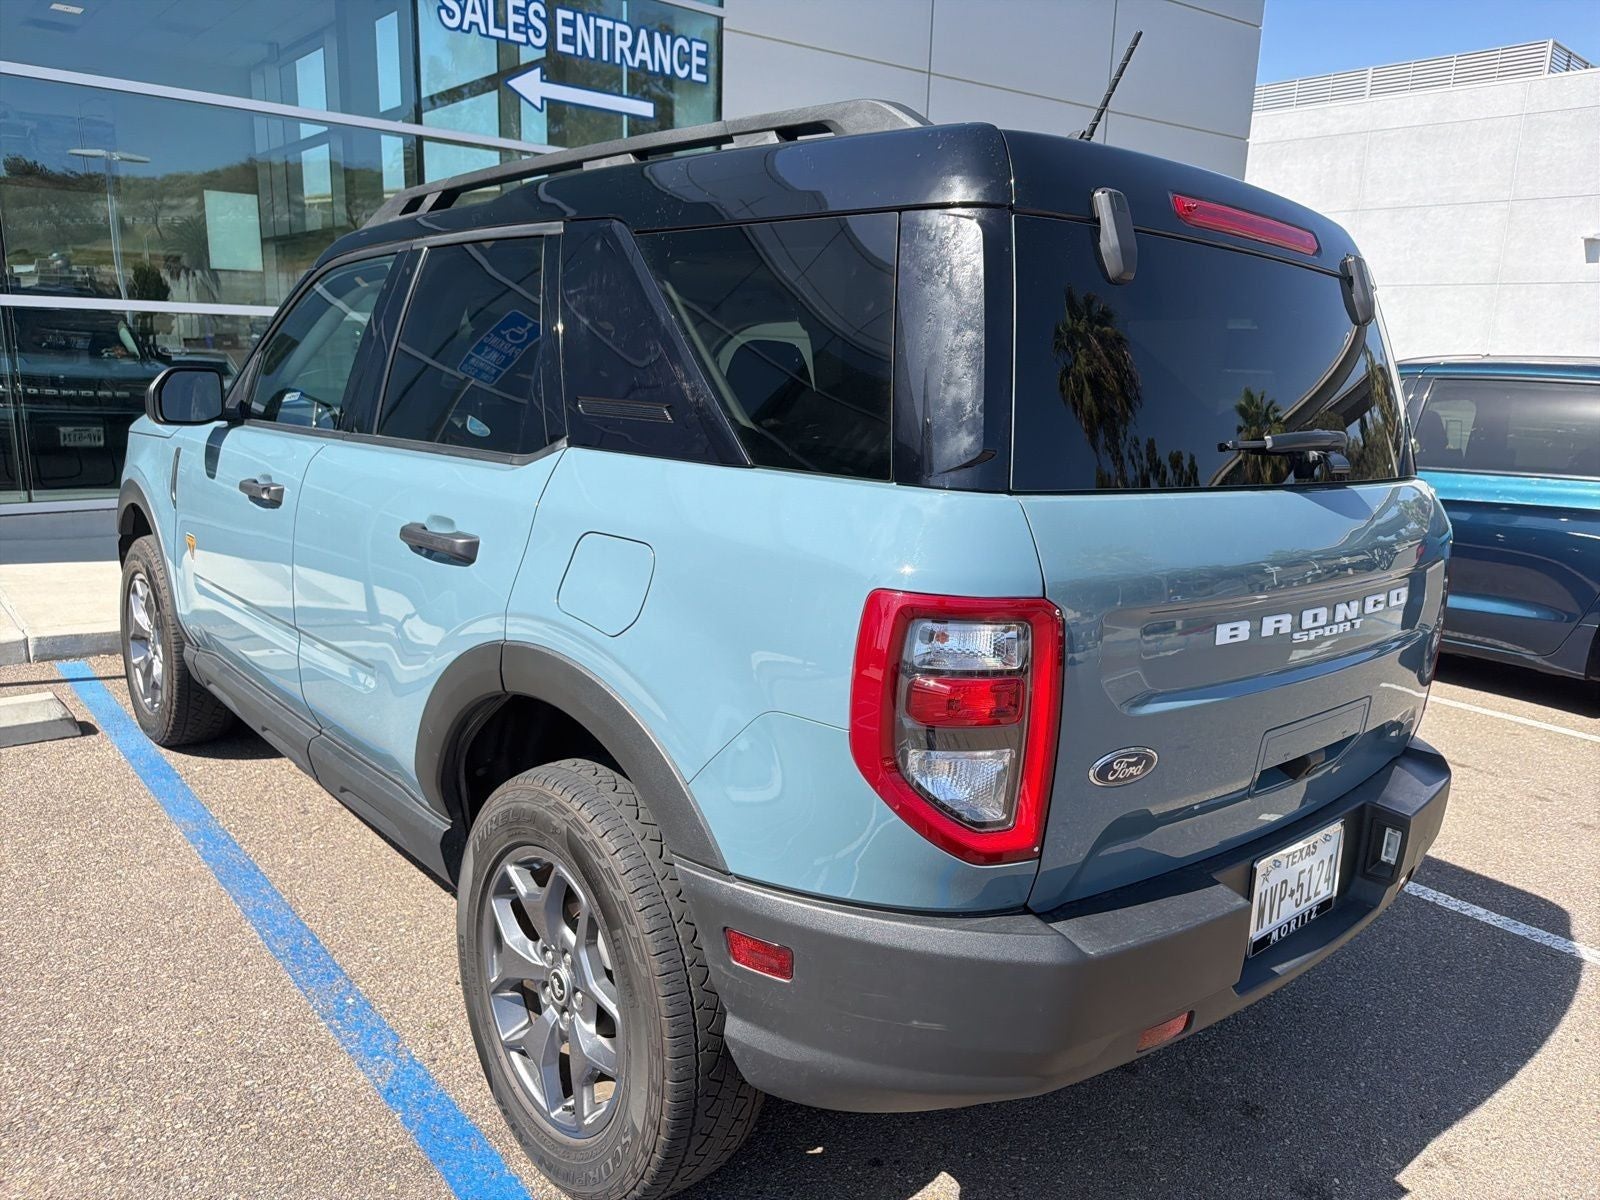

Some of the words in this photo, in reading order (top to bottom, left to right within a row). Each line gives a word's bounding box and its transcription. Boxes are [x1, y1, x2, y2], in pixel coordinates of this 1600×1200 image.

[438, 0, 547, 49] SALES
[555, 7, 709, 84] ENTRANCE
[1214, 586, 1409, 646] BRONCO
[1292, 618, 1364, 643] SPORT
[1108, 757, 1146, 780] Ford
[1284, 841, 1318, 869] TEXAS
[1269, 908, 1318, 945] MORITZ
